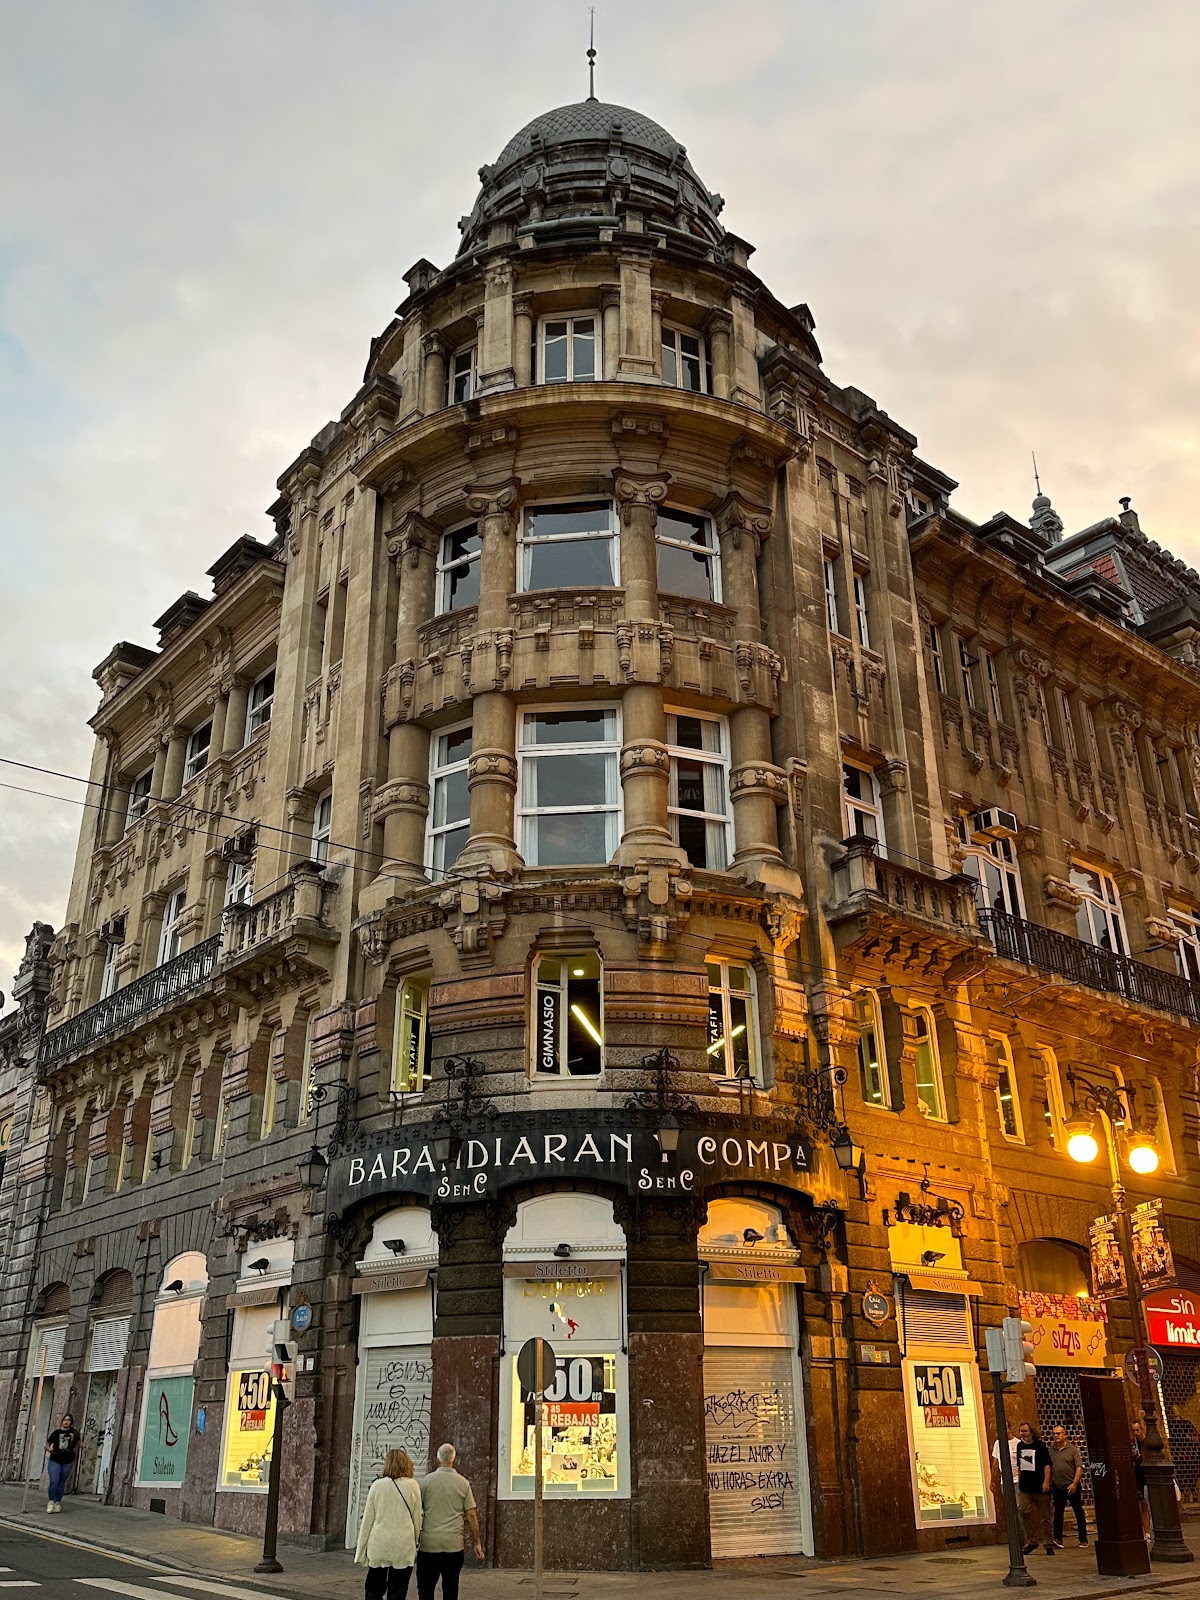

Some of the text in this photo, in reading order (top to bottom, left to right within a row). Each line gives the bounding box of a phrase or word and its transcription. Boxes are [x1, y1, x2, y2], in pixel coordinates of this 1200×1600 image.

[543, 996, 554, 1068] GIMNASIO
[710, 1008, 720, 1059] ATAFIT
[535, 1263, 588, 1277] Stiletto
[736, 1265, 780, 1280] Stiletto
[372, 1276, 406, 1290] Stiletto
[550, 1413, 599, 1426] REBAJAS
[153, 1456, 175, 1475] Stiletto
[708, 1470, 794, 1490] NO HORAS EXTRA
